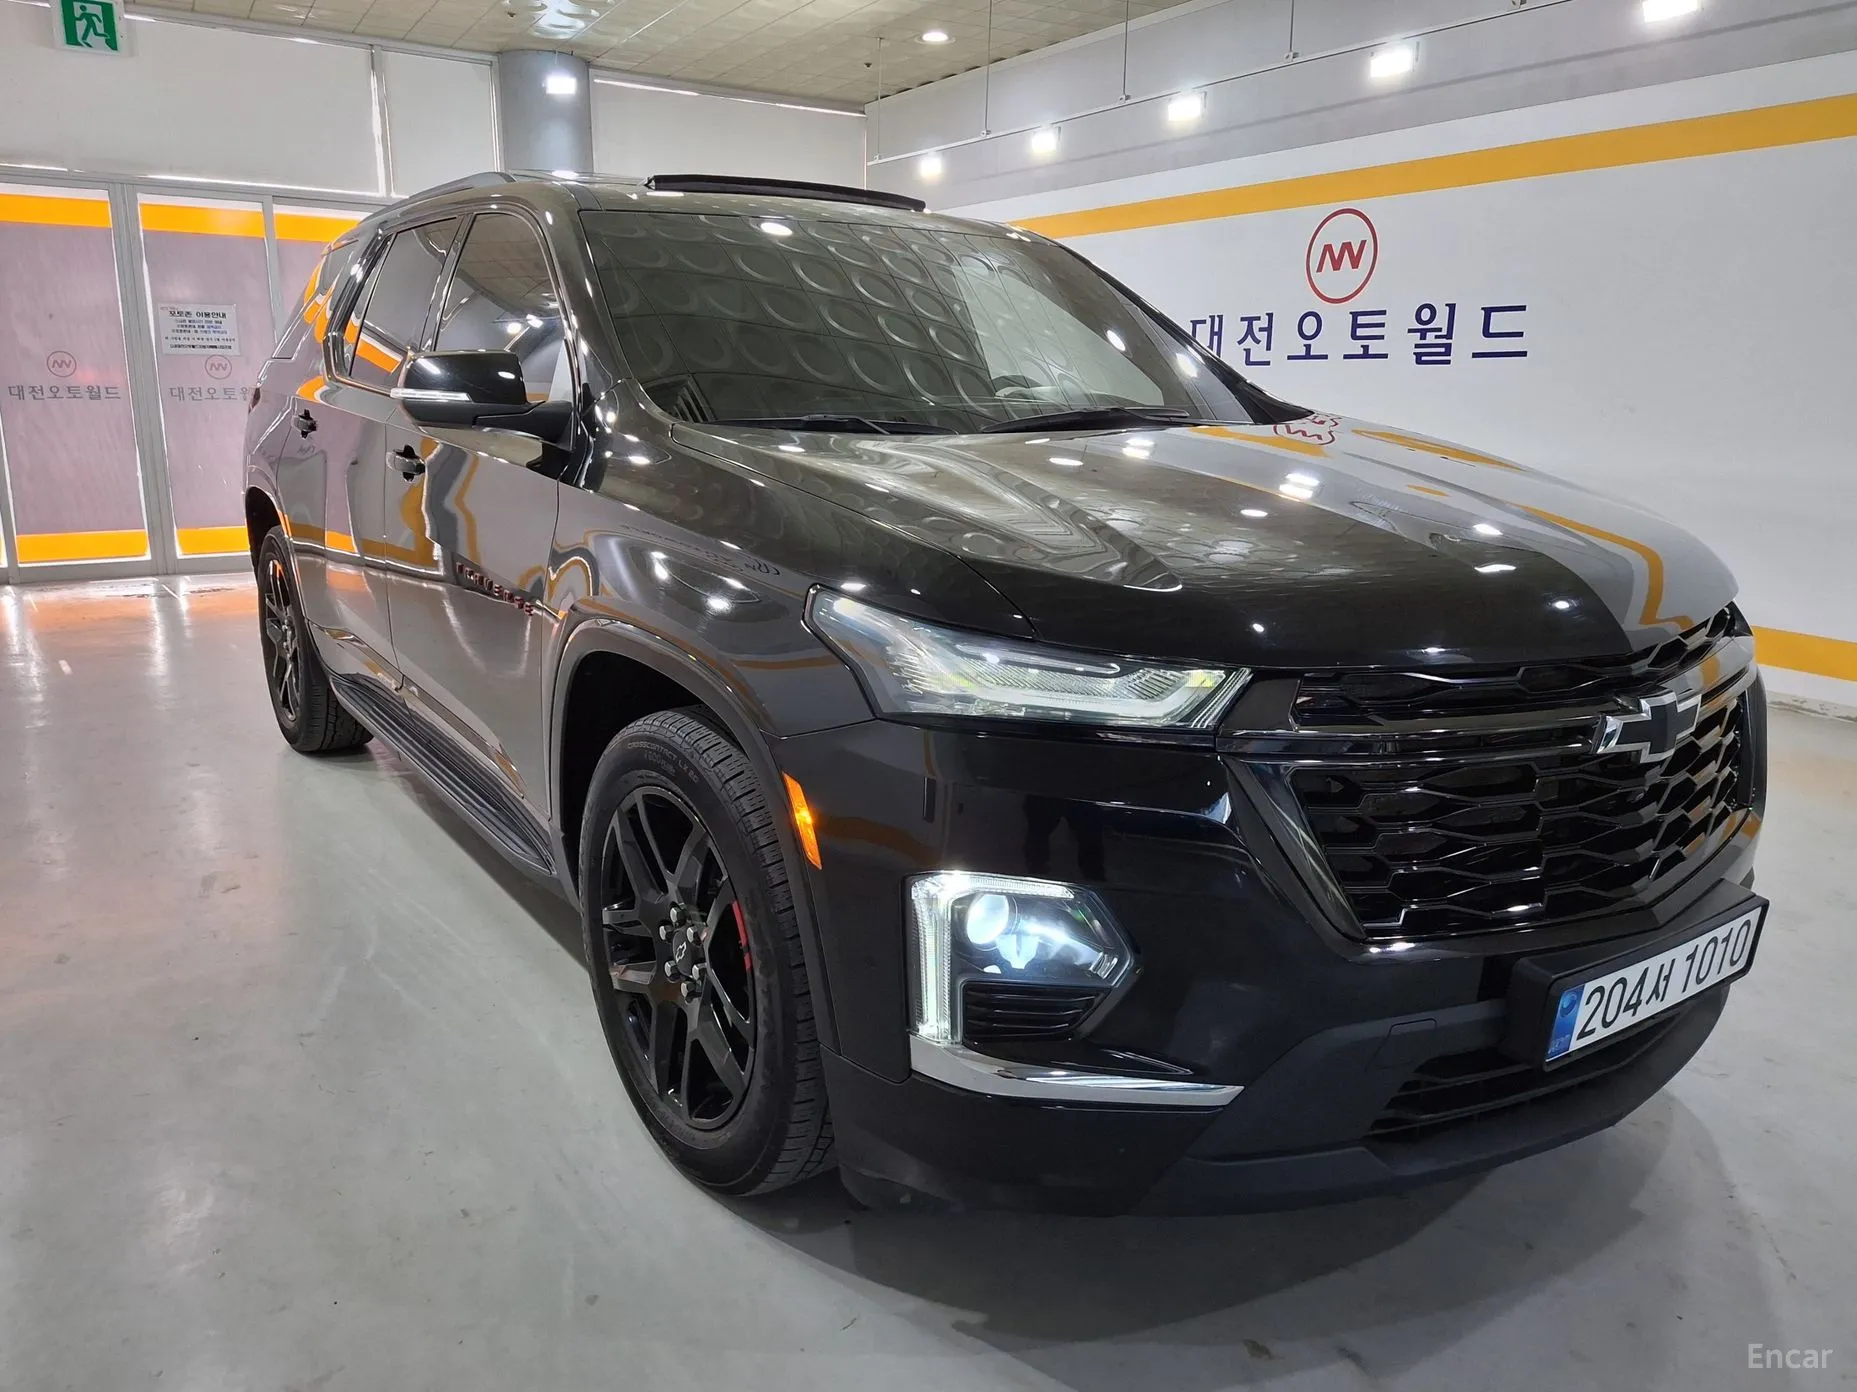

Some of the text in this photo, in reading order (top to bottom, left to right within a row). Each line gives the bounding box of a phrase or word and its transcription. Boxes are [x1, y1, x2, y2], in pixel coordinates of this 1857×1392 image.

[195, 311, 227, 319] 이용안내
[1190, 303, 1528, 366] 대전오토월드
[8, 385, 121, 401] 대전오토월드
[1576, 919, 1751, 1041] 204서 1010
